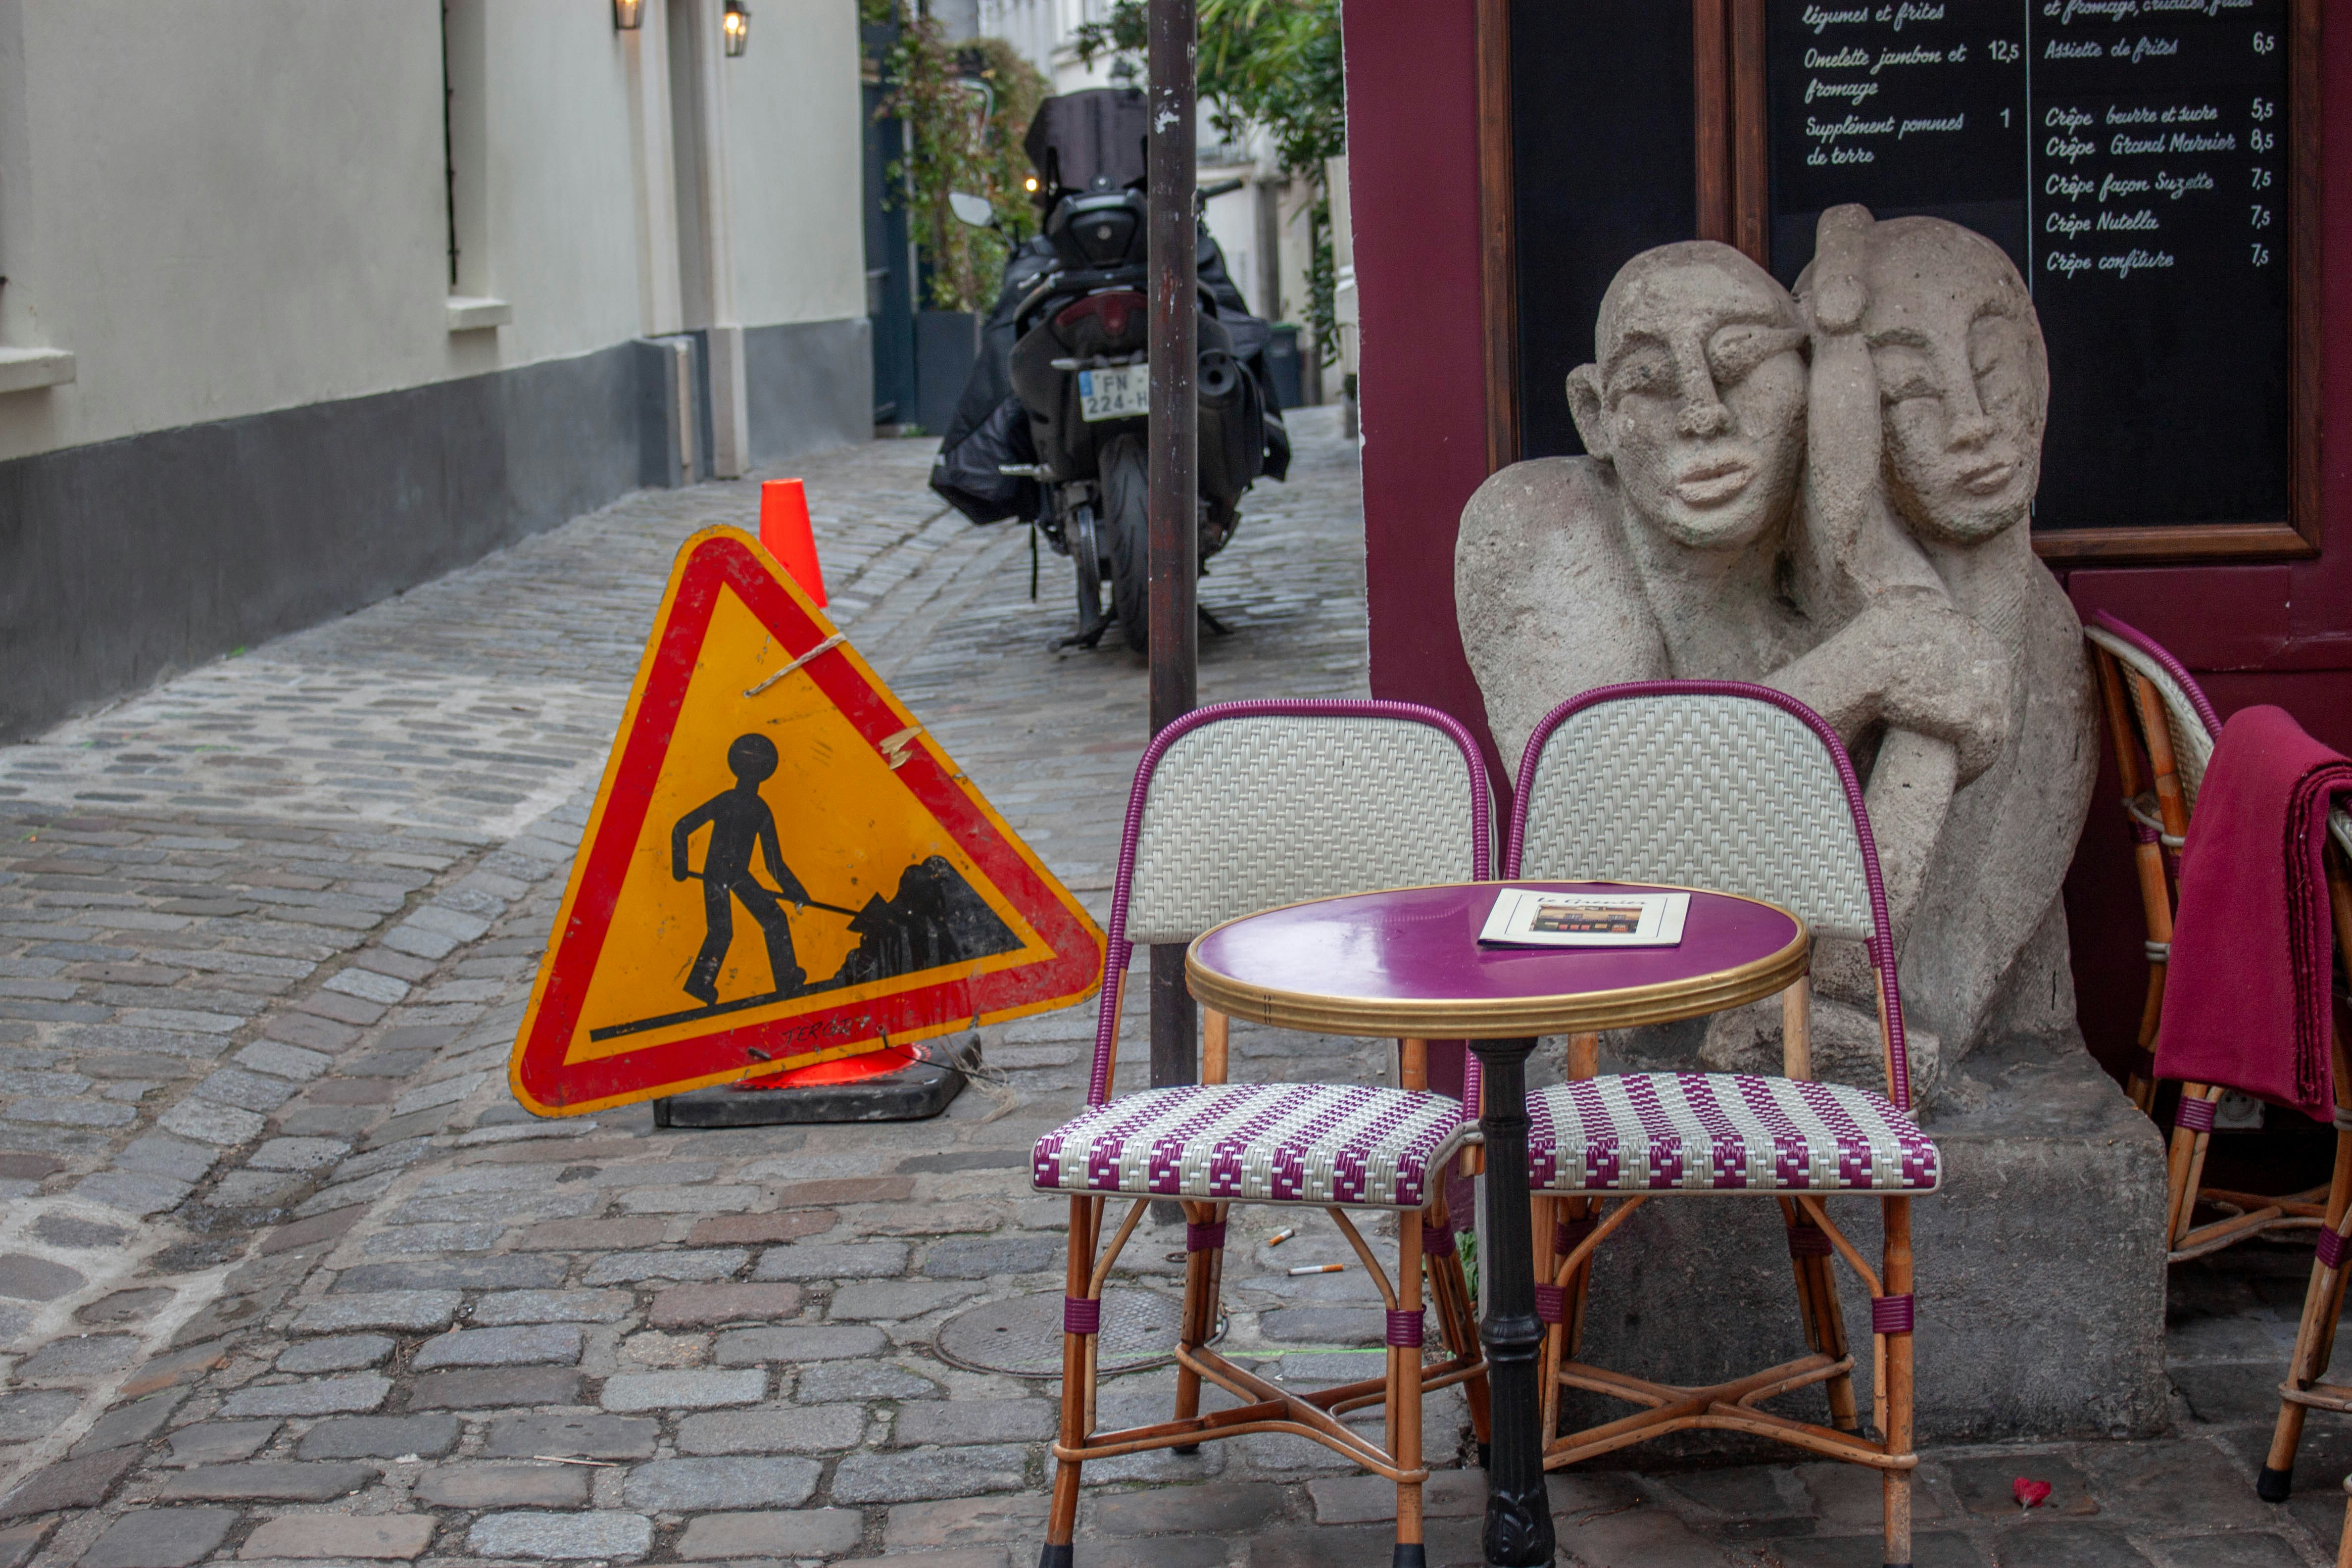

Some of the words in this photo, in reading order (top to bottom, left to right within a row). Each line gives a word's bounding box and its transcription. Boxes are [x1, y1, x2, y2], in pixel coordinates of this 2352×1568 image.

[1802, 4, 1868, 34] légumes
[1875, 4, 1892, 21] et
[1894, 2, 1944, 32] frites
[2044, 0, 2061, 16] et
[1804, 47, 1869, 68] Omelette
[1870, 45, 1942, 75] jambon
[1948, 44, 1967, 62] et
[1988, 40, 2019, 63] 12,5
[2044, 40, 2102, 59] Assiette
[2111, 38, 2130, 56] de
[2132, 37, 2178, 63] frites
[2254, 32, 2274, 54] 6,5
[1805, 78, 1878, 105] fromage
[1806, 115, 1895, 144] Supplément
[1898, 113, 1964, 140] pommes
[2000, 108, 2009, 128] 1
[2045, 107, 2093, 135] Crêpe
[2106, 105, 2157, 124] beurre
[2161, 106, 2176, 123] et
[2178, 105, 2217, 121] sucre
[2251, 98, 2273, 121] 5,5
[1807, 147, 1828, 165] de
[1831, 147, 1874, 164] terre
[2046, 137, 2095, 164] Crêpe
[2110, 134, 2165, 154] Grand
[2169, 132, 2235, 152] Marnier
[2251, 129, 2273, 152] 8,5
[2045, 174, 2094, 202] Crêpe
[2099, 173, 2150, 202] façon
[2155, 171, 2213, 199] Suzette
[2252, 168, 2271, 190] 7,5
[2046, 212, 2091, 240] Crêpe
[2096, 210, 2159, 230] Nutella
[2252, 205, 2270, 229] 7,5
[2047, 251, 2092, 279] Crêpe
[2098, 249, 2173, 279] confiture
[2252, 244, 2268, 267] 7,5
